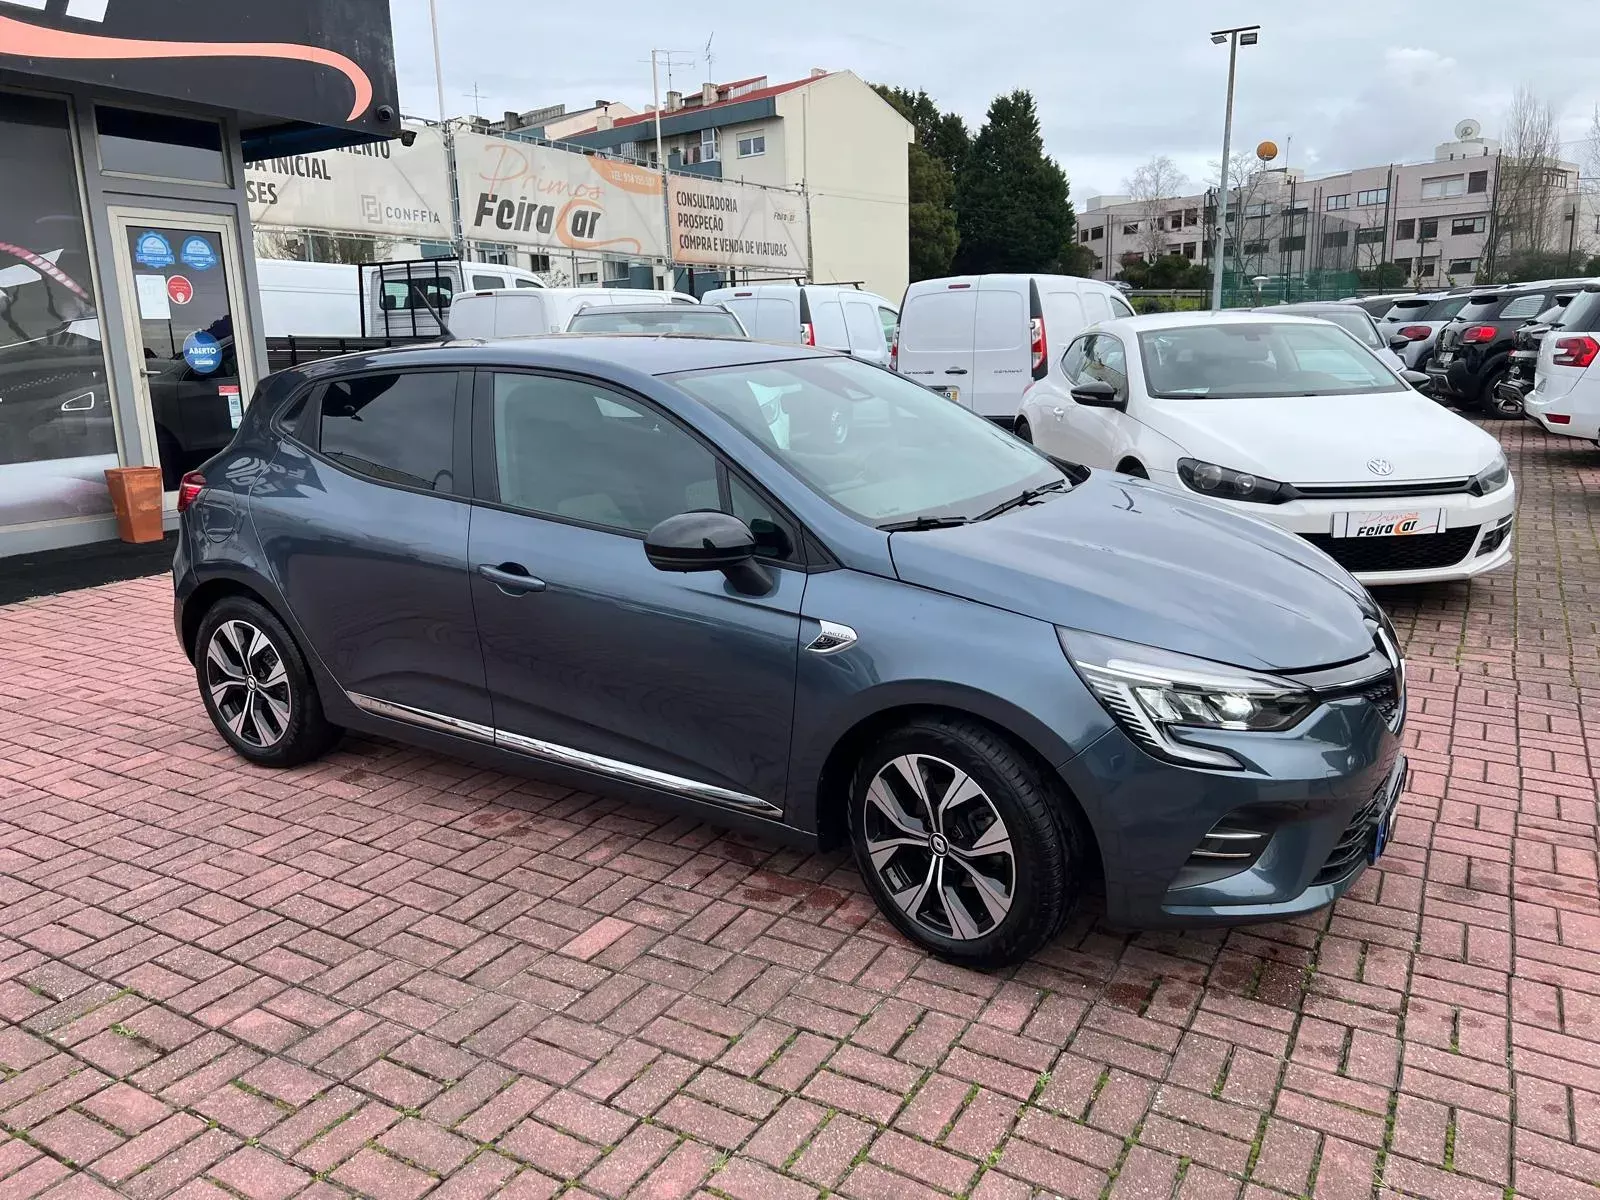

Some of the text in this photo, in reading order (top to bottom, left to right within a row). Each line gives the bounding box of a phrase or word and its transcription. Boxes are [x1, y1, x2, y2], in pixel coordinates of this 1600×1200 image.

[271, 155, 331, 181] INICIAL
[676, 191, 738, 213] CONSULTADORIA
[386, 206, 441, 224] CONFFIA
[678, 213, 724, 233] PROSPEÇÃO
[679, 234, 788, 257] COMPRA E VENDA DE VIATURAS
[188, 347, 217, 355] ABERTO
